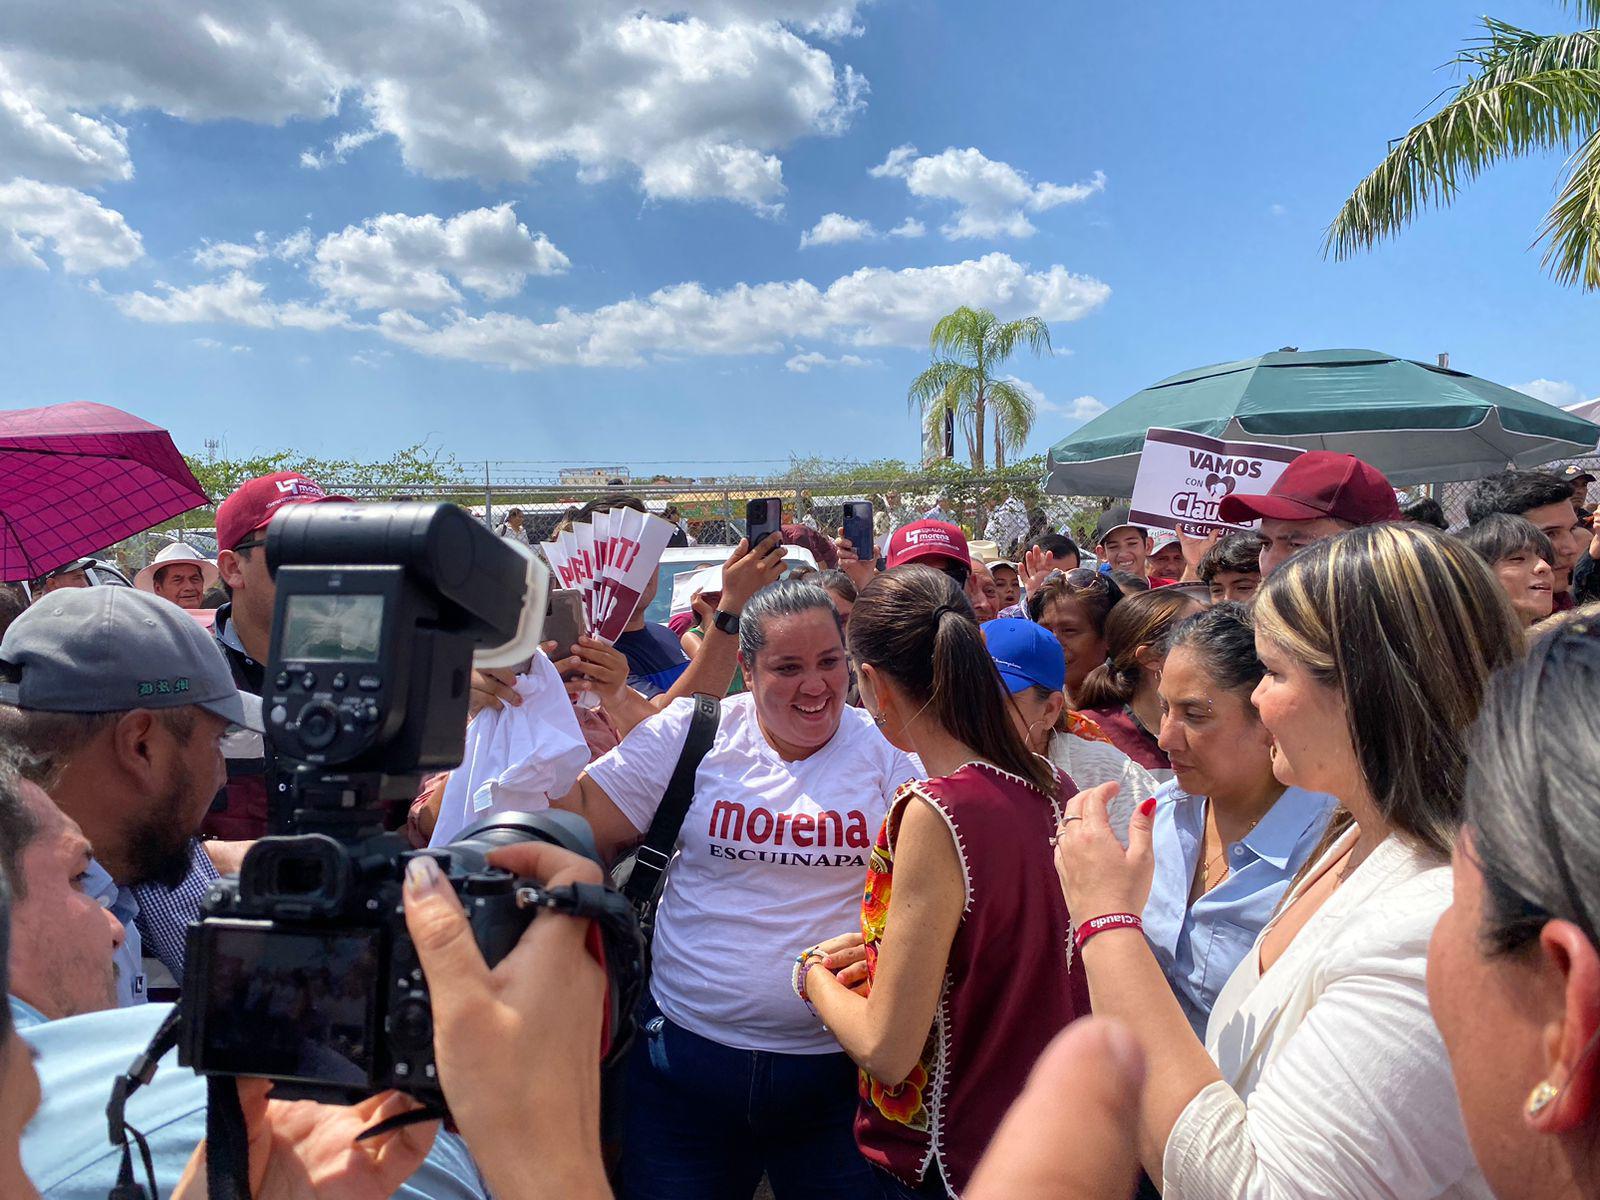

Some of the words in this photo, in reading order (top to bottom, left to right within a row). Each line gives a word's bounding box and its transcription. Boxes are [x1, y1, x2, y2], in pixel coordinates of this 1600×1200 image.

[1189, 450, 1262, 479] VAMOS
[1185, 477, 1203, 488] CON
[920, 533, 950, 541] morena
[708, 799, 871, 849] morena
[708, 843, 866, 867] ESCUINAPA
